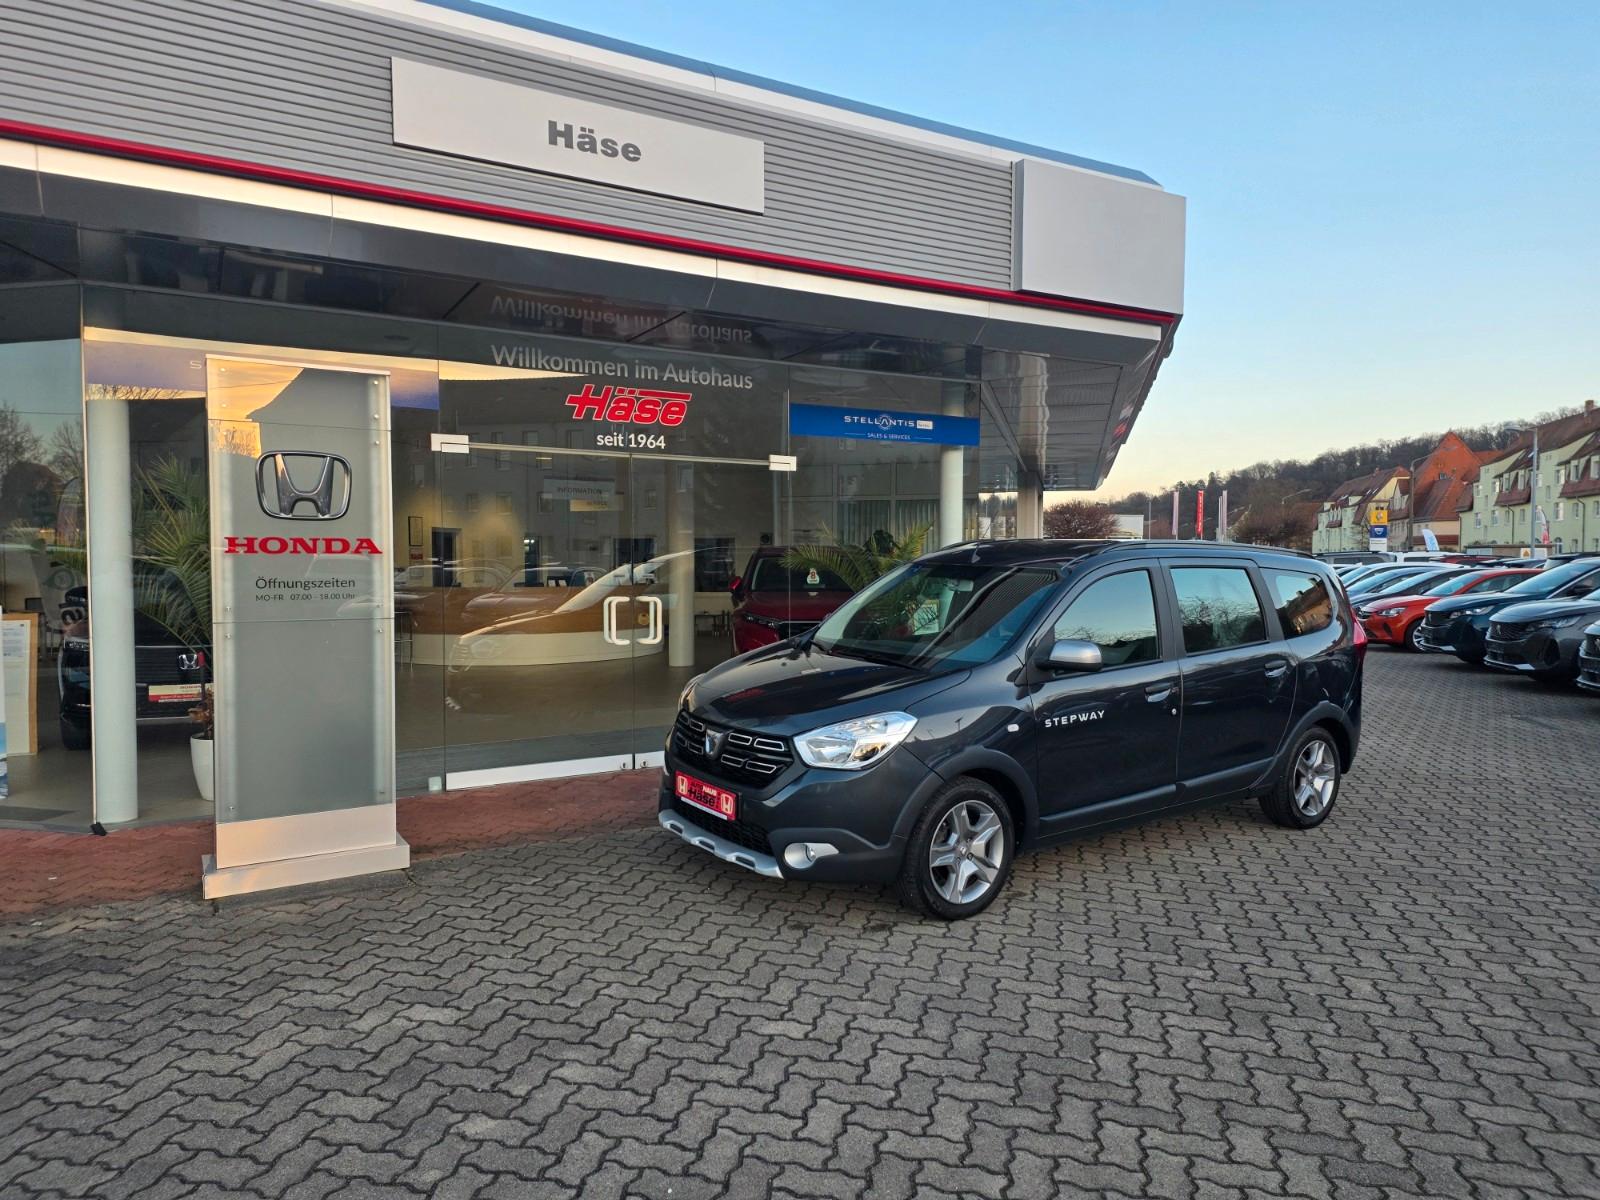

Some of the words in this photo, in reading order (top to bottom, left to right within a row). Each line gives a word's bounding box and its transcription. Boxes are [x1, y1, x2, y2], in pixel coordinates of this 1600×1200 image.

[548, 120, 641, 161] Häse
[491, 344, 628, 378] Willkommen
[635, 359, 658, 380] im
[663, 362, 753, 389] Autohaus
[565, 384, 692, 426] Häse
[844, 414, 915, 429] STELLANTIS
[596, 432, 624, 447] seit
[628, 433, 666, 449] 1964
[224, 537, 383, 555] HONDA
[255, 576, 356, 591] Öffnungszeiten
[255, 594, 285, 602] MO-FR
[290, 593, 313, 601] 07.00
[1045, 710, 1105, 728] STEPWAY
